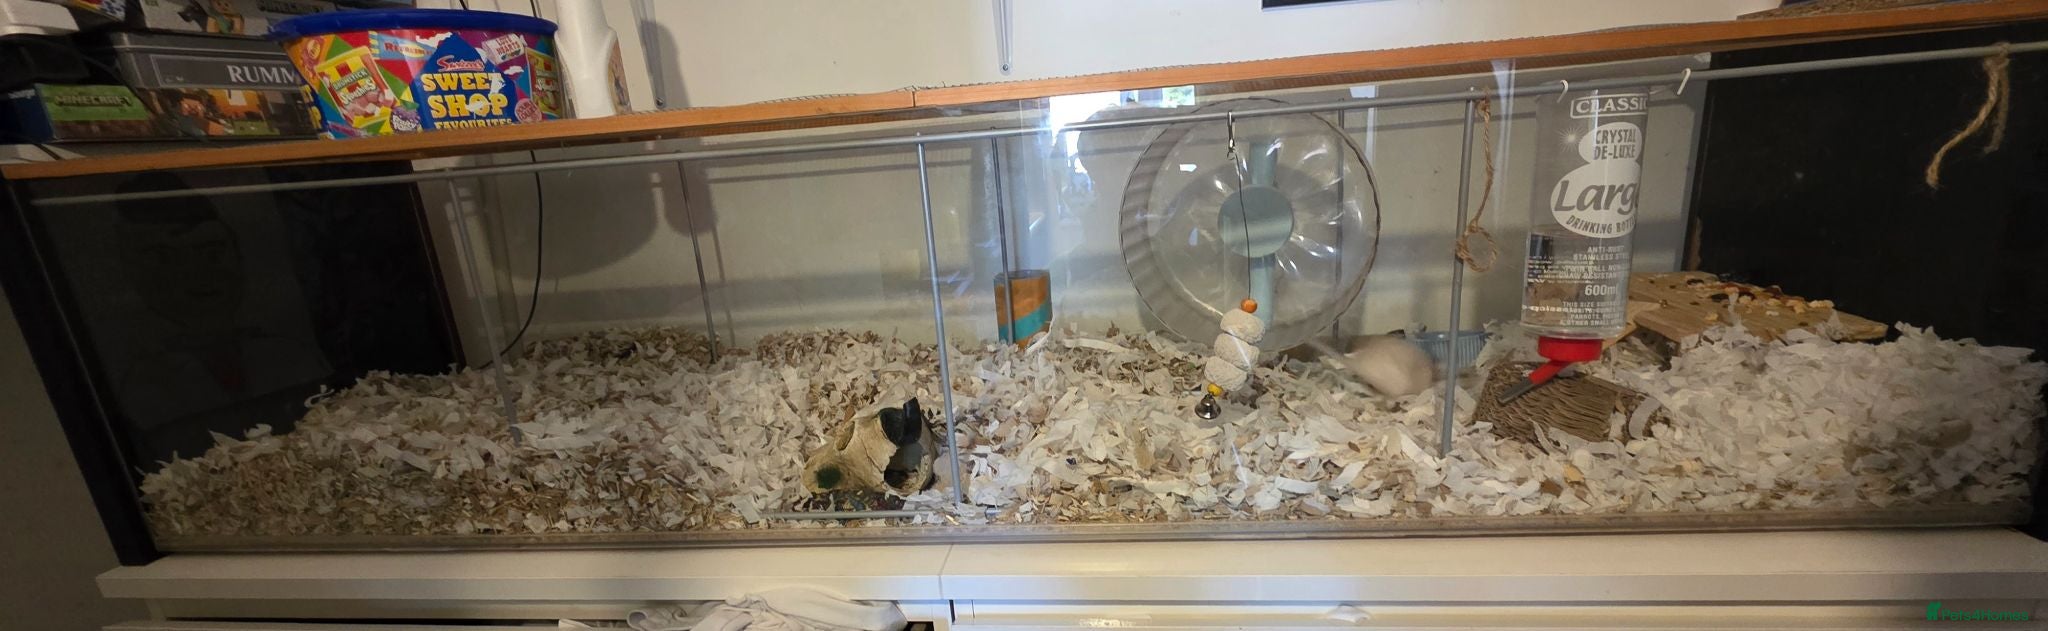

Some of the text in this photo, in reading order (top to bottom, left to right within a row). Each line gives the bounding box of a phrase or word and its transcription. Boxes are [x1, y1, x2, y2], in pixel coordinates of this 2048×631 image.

[421, 73, 503, 92] SWEET
[428, 93, 508, 118] SHOP
[1596, 129, 1636, 144] CRYSTAL
[1594, 145, 1635, 160] DE-LUXE
[1566, 215, 1612, 234] DRINKING
[1584, 284, 1618, 296] 600ml
